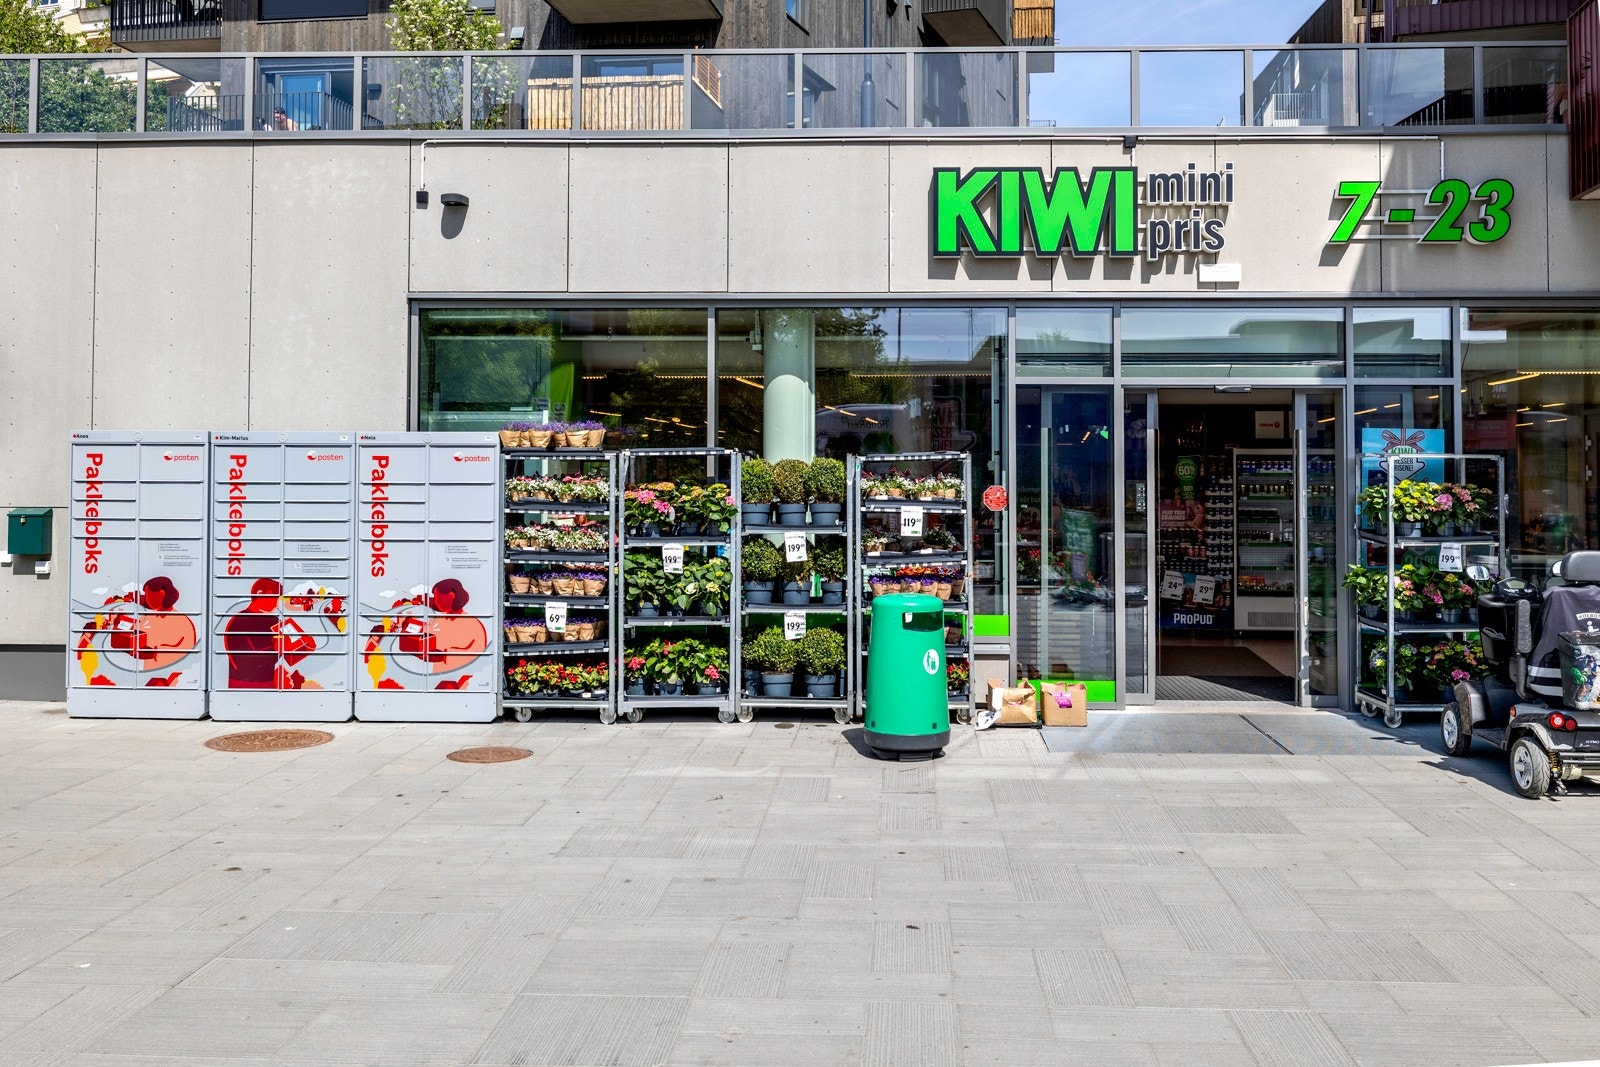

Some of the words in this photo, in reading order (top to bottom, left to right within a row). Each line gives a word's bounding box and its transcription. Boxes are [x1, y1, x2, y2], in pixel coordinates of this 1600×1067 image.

[1149, 162, 1234, 204] mini
[933, 166, 1138, 258] KIWI
[1148, 209, 1225, 261] pris
[173, 454, 199, 462] posten
[317, 453, 344, 462] posten
[464, 455, 490, 463] posten
[85, 453, 103, 574] Pakkeboks
[228, 455, 247, 576] Pakkeboks
[371, 455, 390, 577] Pakkeboks
[903, 518, 916, 527] 119
[788, 544, 801, 552] 199
[664, 556, 677, 564] 199
[1441, 554, 1455, 563] 199
[549, 614, 560, 622] 69
[787, 622, 801, 631] 199
